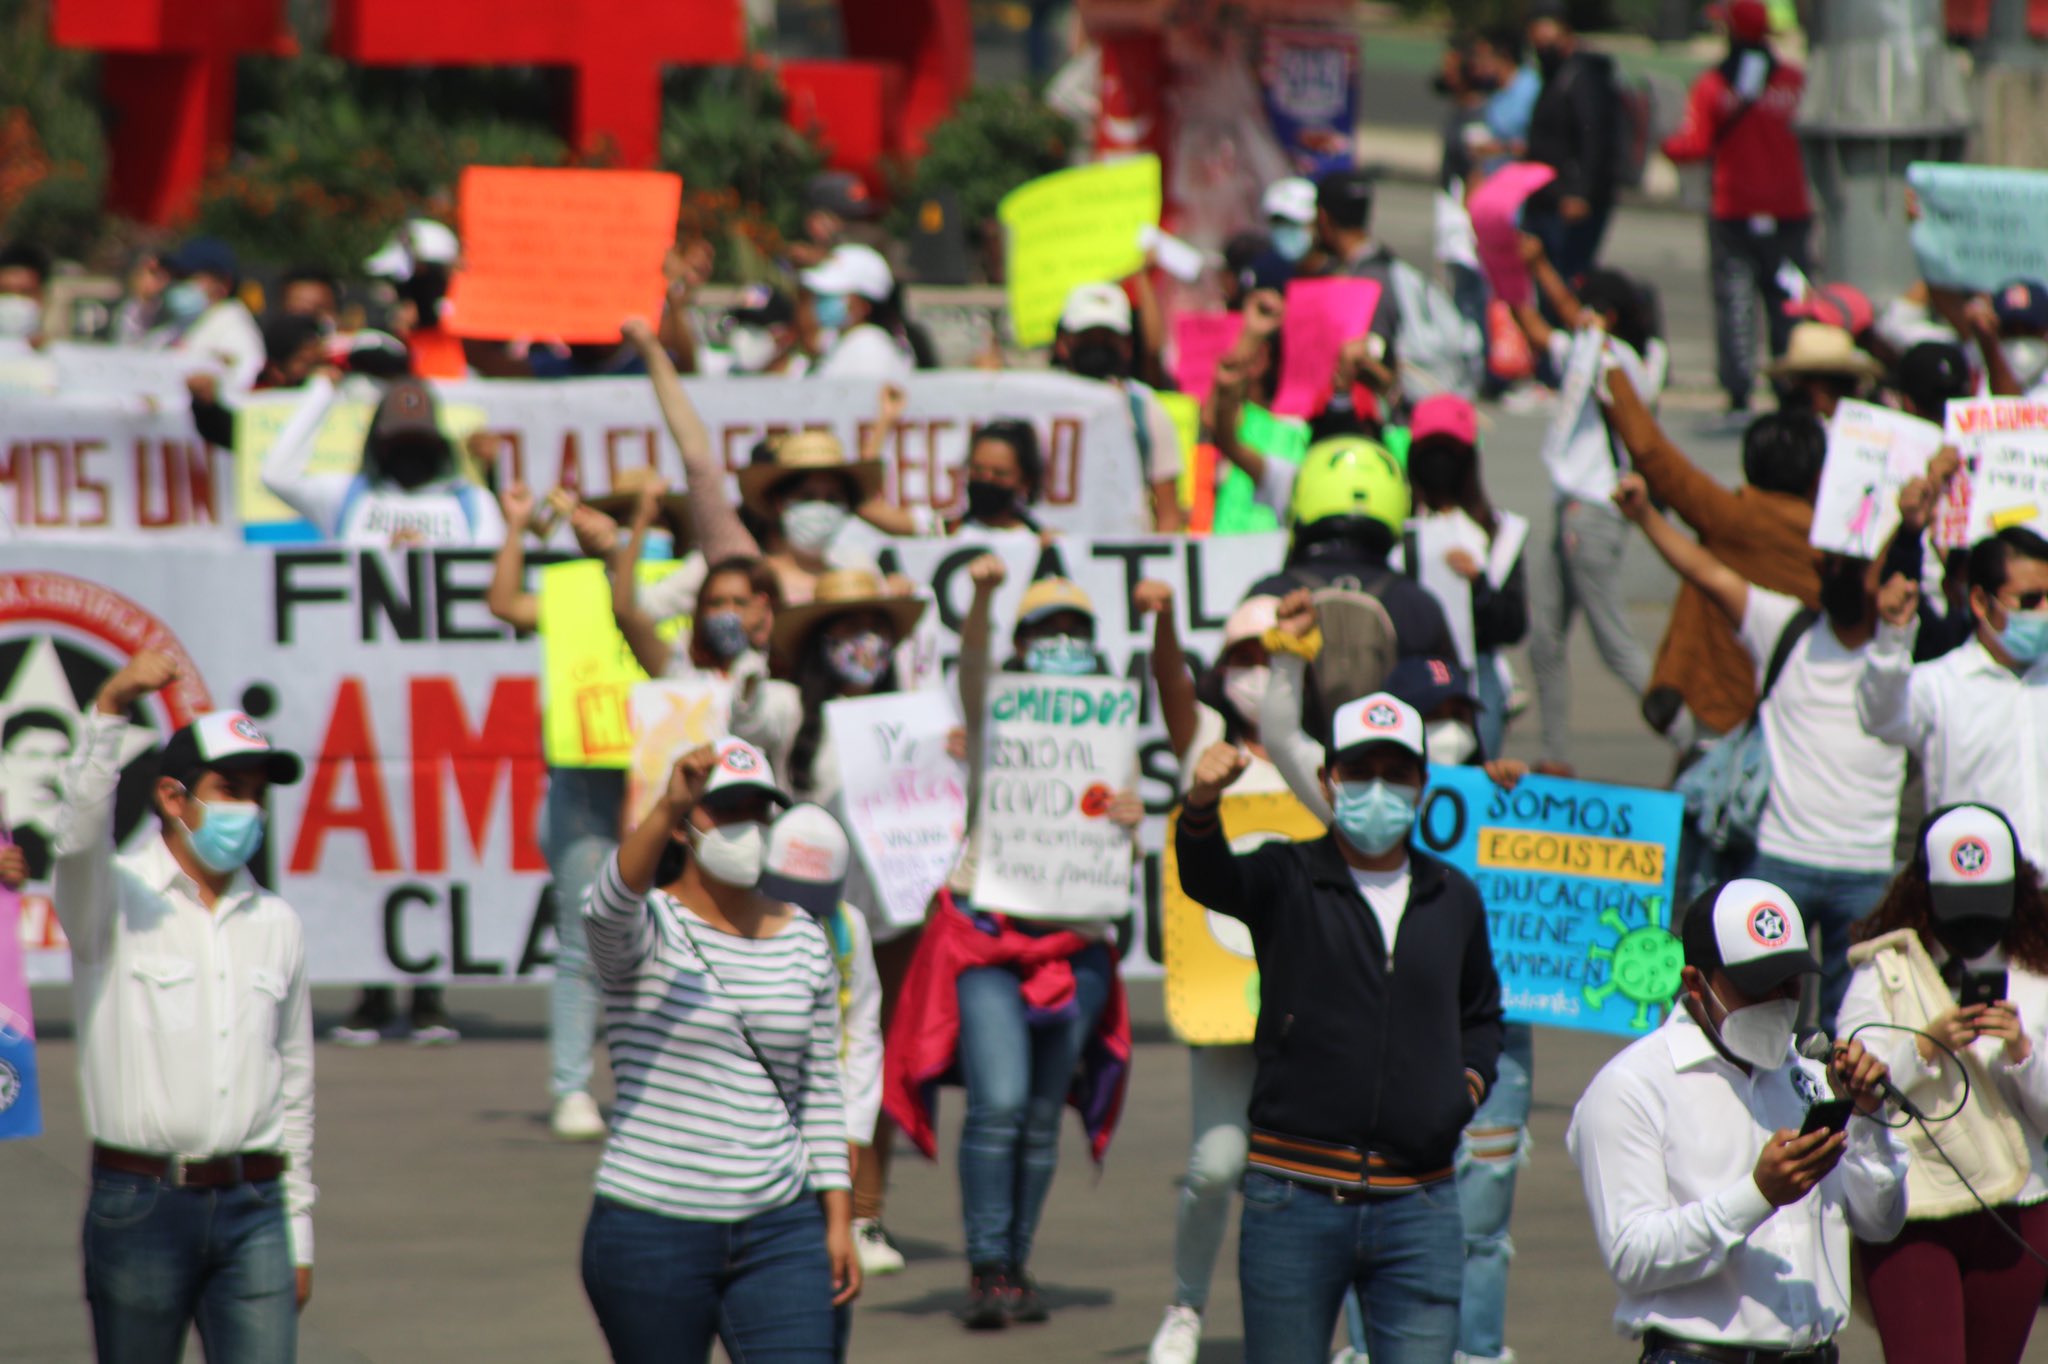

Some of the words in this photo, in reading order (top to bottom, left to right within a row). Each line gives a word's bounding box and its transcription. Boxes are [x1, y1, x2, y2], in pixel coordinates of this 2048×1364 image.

[135, 438, 220, 528] UN
[1488, 787, 1634, 838] SOMOS
[1489, 834, 1659, 878] EGOISTAS
[1488, 909, 1583, 945] TIENE
